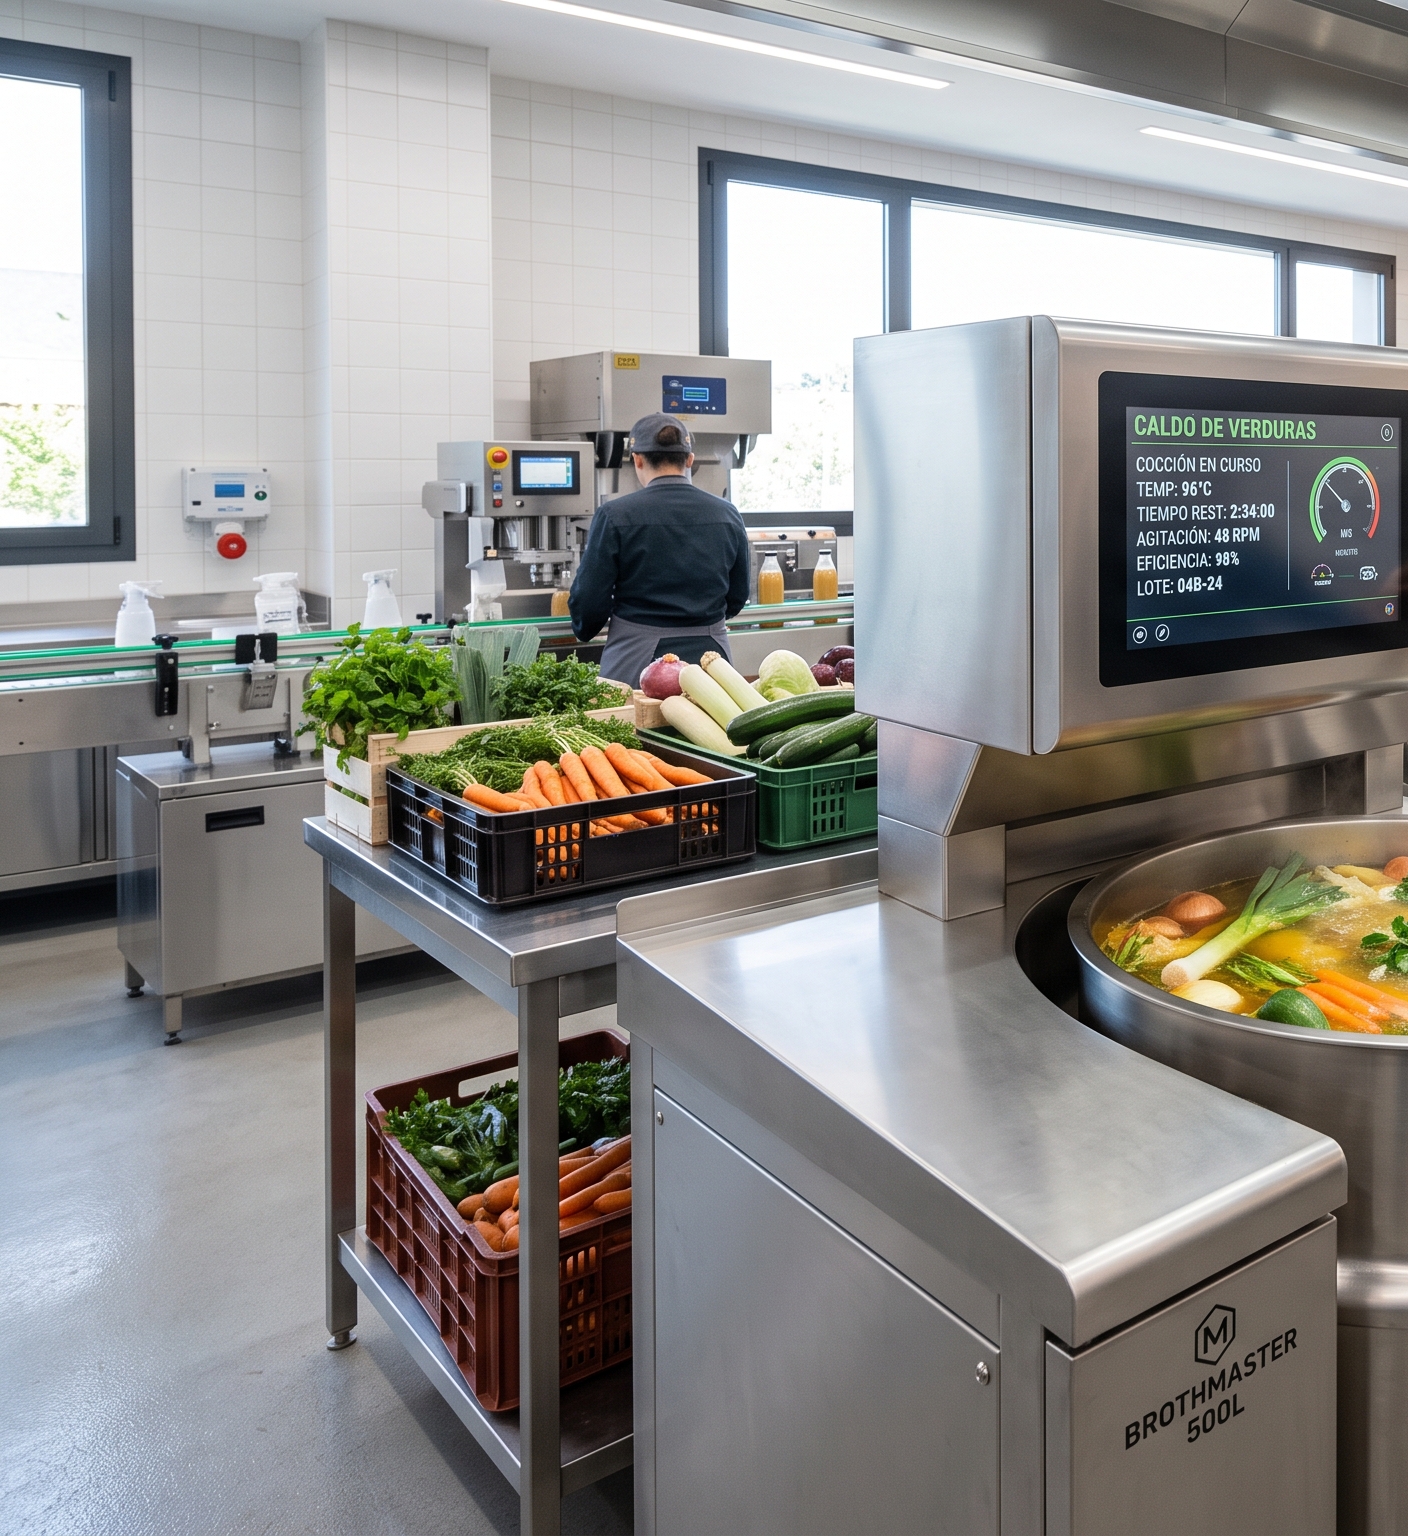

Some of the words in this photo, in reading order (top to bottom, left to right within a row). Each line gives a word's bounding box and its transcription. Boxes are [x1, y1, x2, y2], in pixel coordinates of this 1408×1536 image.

[1134, 414, 1196, 437] CALDO
[1201, 416, 1224, 438] DE
[1228, 418, 1316, 440] VERDURAS
[1136, 453, 1196, 473] COCCIÓN
[1200, 457, 1216, 472] EN
[1220, 457, 1261, 473] CURSO
[1136, 481, 1178, 497] TEMP:
[1137, 505, 1188, 522] TIEMPO
[1192, 504, 1227, 520] REST:
[1230, 503, 1275, 519] 2:34:00
[1136, 526, 1211, 547] AGITACIÓN:
[1214, 528, 1230, 543] 48
[1233, 527, 1260, 542] RPM
[1137, 552, 1212, 571] EFICIENCIA:
[1215, 551, 1240, 567] 98%
[1137, 578, 1174, 596] LOTE:
[1177, 575, 1223, 593] 04B-24
[1203, 1316, 1228, 1355] M
[1125, 1327, 1298, 1451] BROTHMASTER
[1187, 1393, 1245, 1443] 500L
